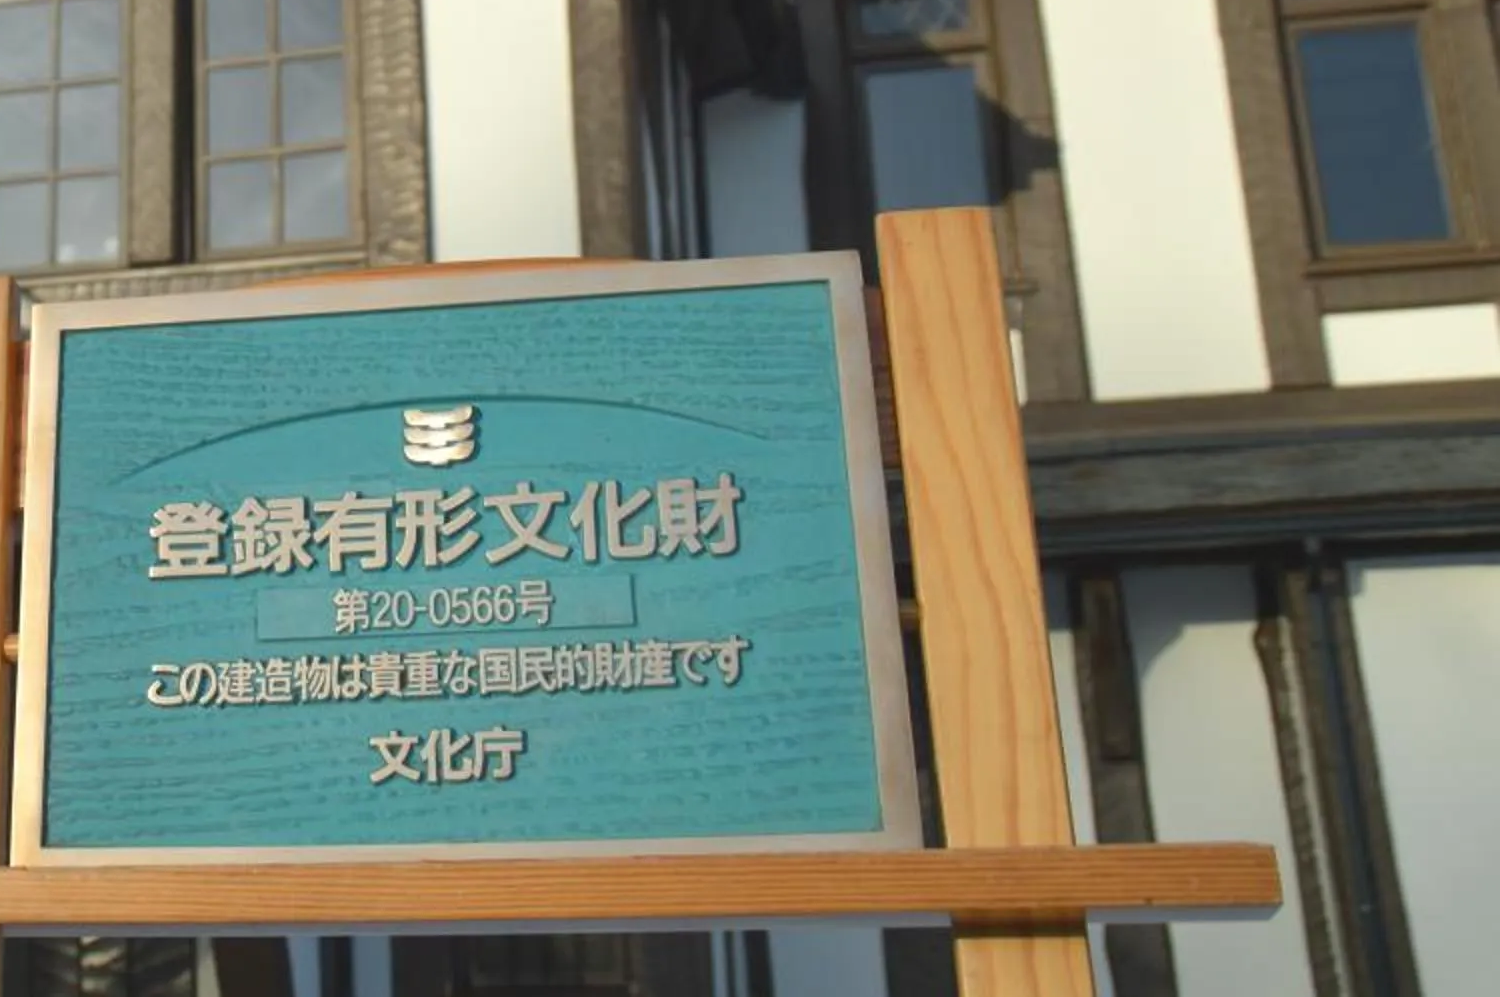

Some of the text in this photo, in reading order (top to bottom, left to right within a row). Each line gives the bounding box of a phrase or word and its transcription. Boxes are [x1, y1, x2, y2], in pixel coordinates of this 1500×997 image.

[148, 474, 742, 580] 登録有形文化財
[333, 580, 553, 634] 第20-0566号
[146, 637, 749, 706] この建造物は貴重な国民的財産です
[369, 726, 524, 783] 文化庁
